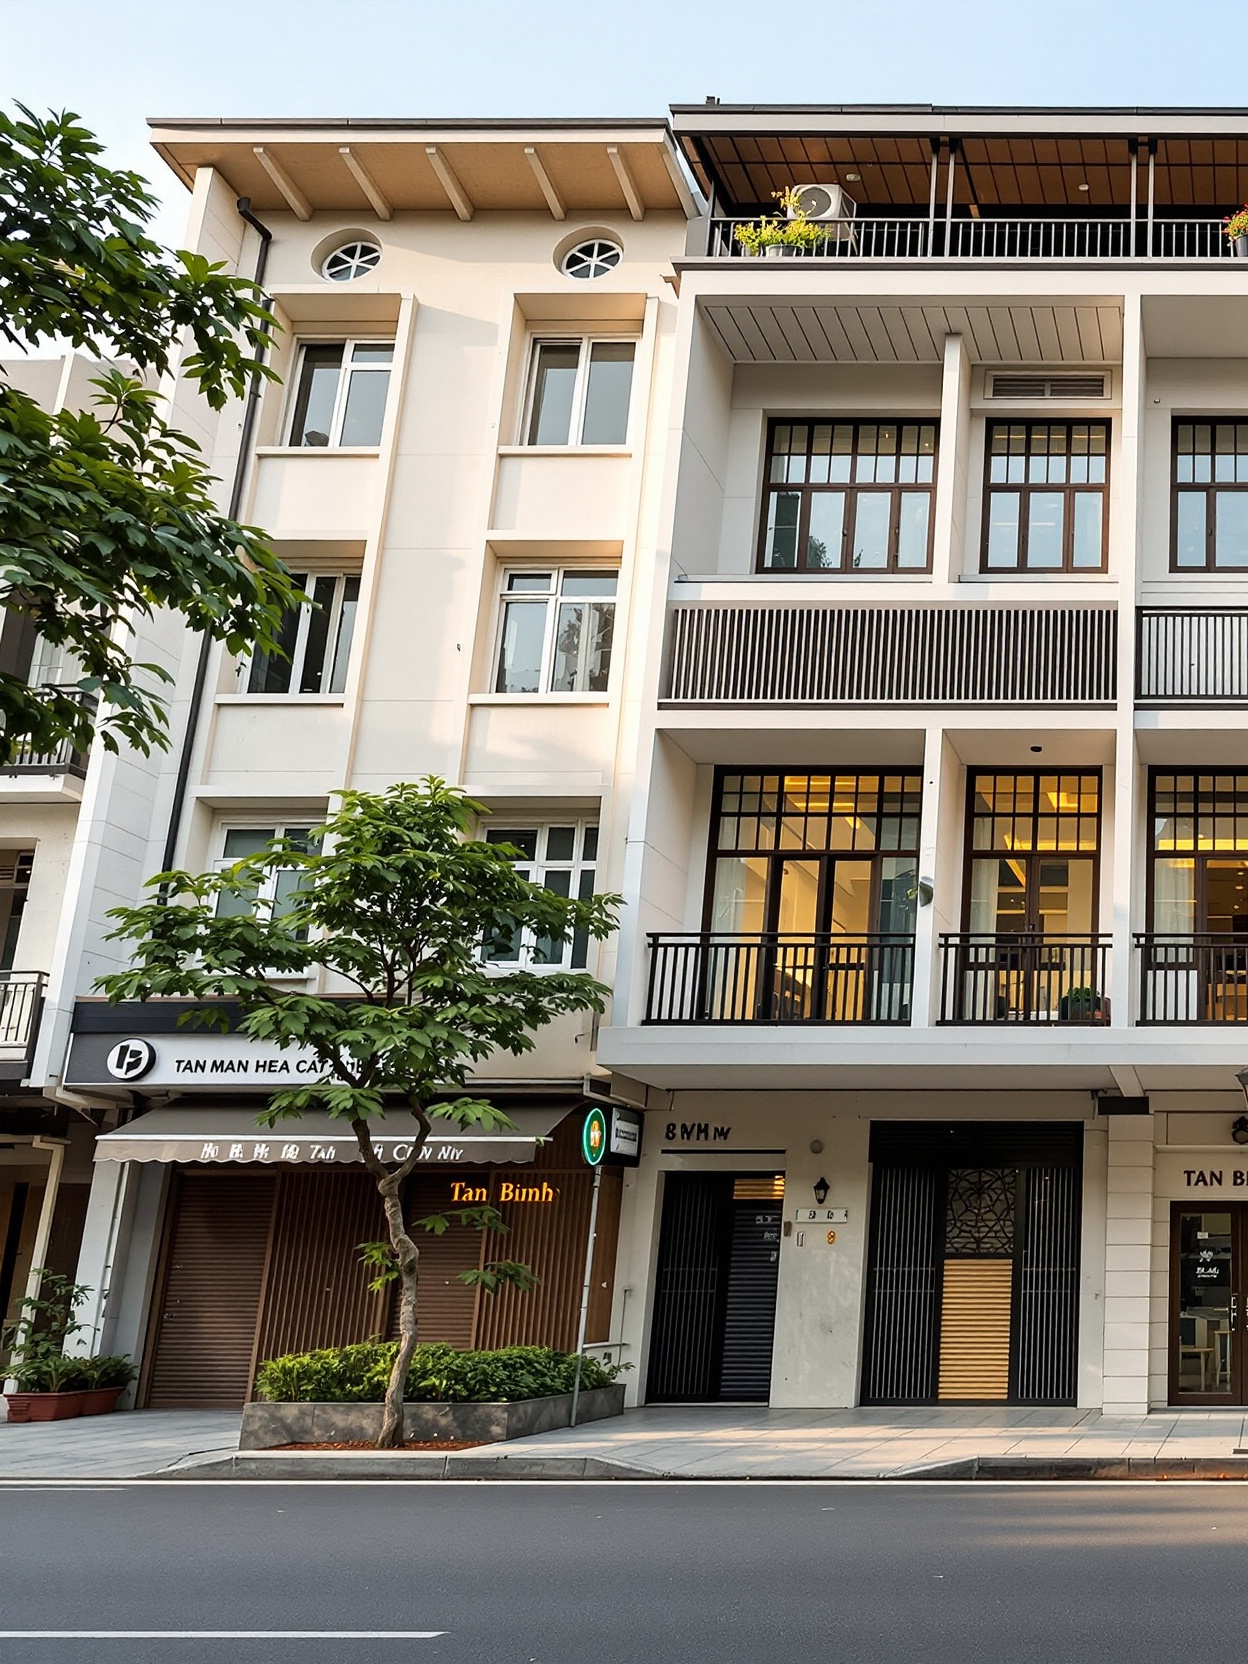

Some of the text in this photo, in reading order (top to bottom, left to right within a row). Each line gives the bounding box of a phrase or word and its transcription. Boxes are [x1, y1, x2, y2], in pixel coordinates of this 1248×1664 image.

[175, 1059, 207, 1073] TAN
[210, 1059, 249, 1073] MAN
[255, 1059, 290, 1073] HEA
[1183, 1170, 1223, 1187] TAN
[450, 1181, 487, 1202] Tan
